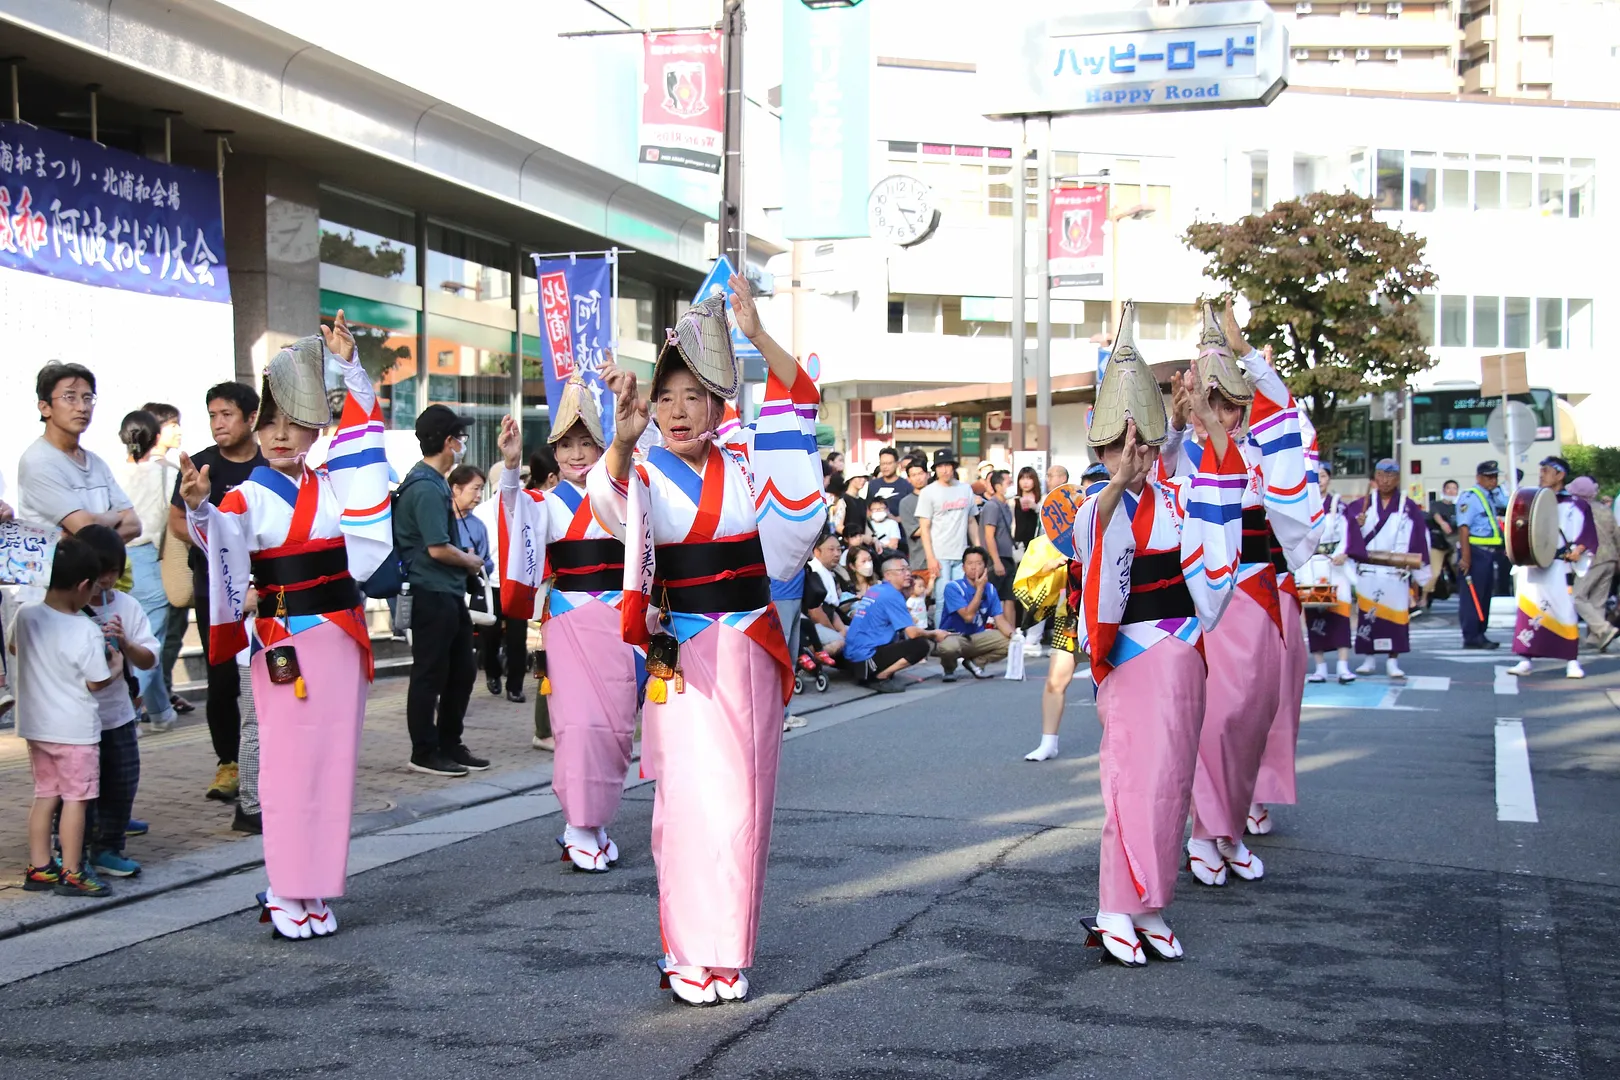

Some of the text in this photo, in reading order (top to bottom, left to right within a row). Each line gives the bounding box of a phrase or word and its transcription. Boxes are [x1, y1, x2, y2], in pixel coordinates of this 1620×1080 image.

[1053, 36, 1255, 76] ハッピーロード
[1086, 83, 1220, 103] Happy Road
[896, 182, 906, 192] 12
